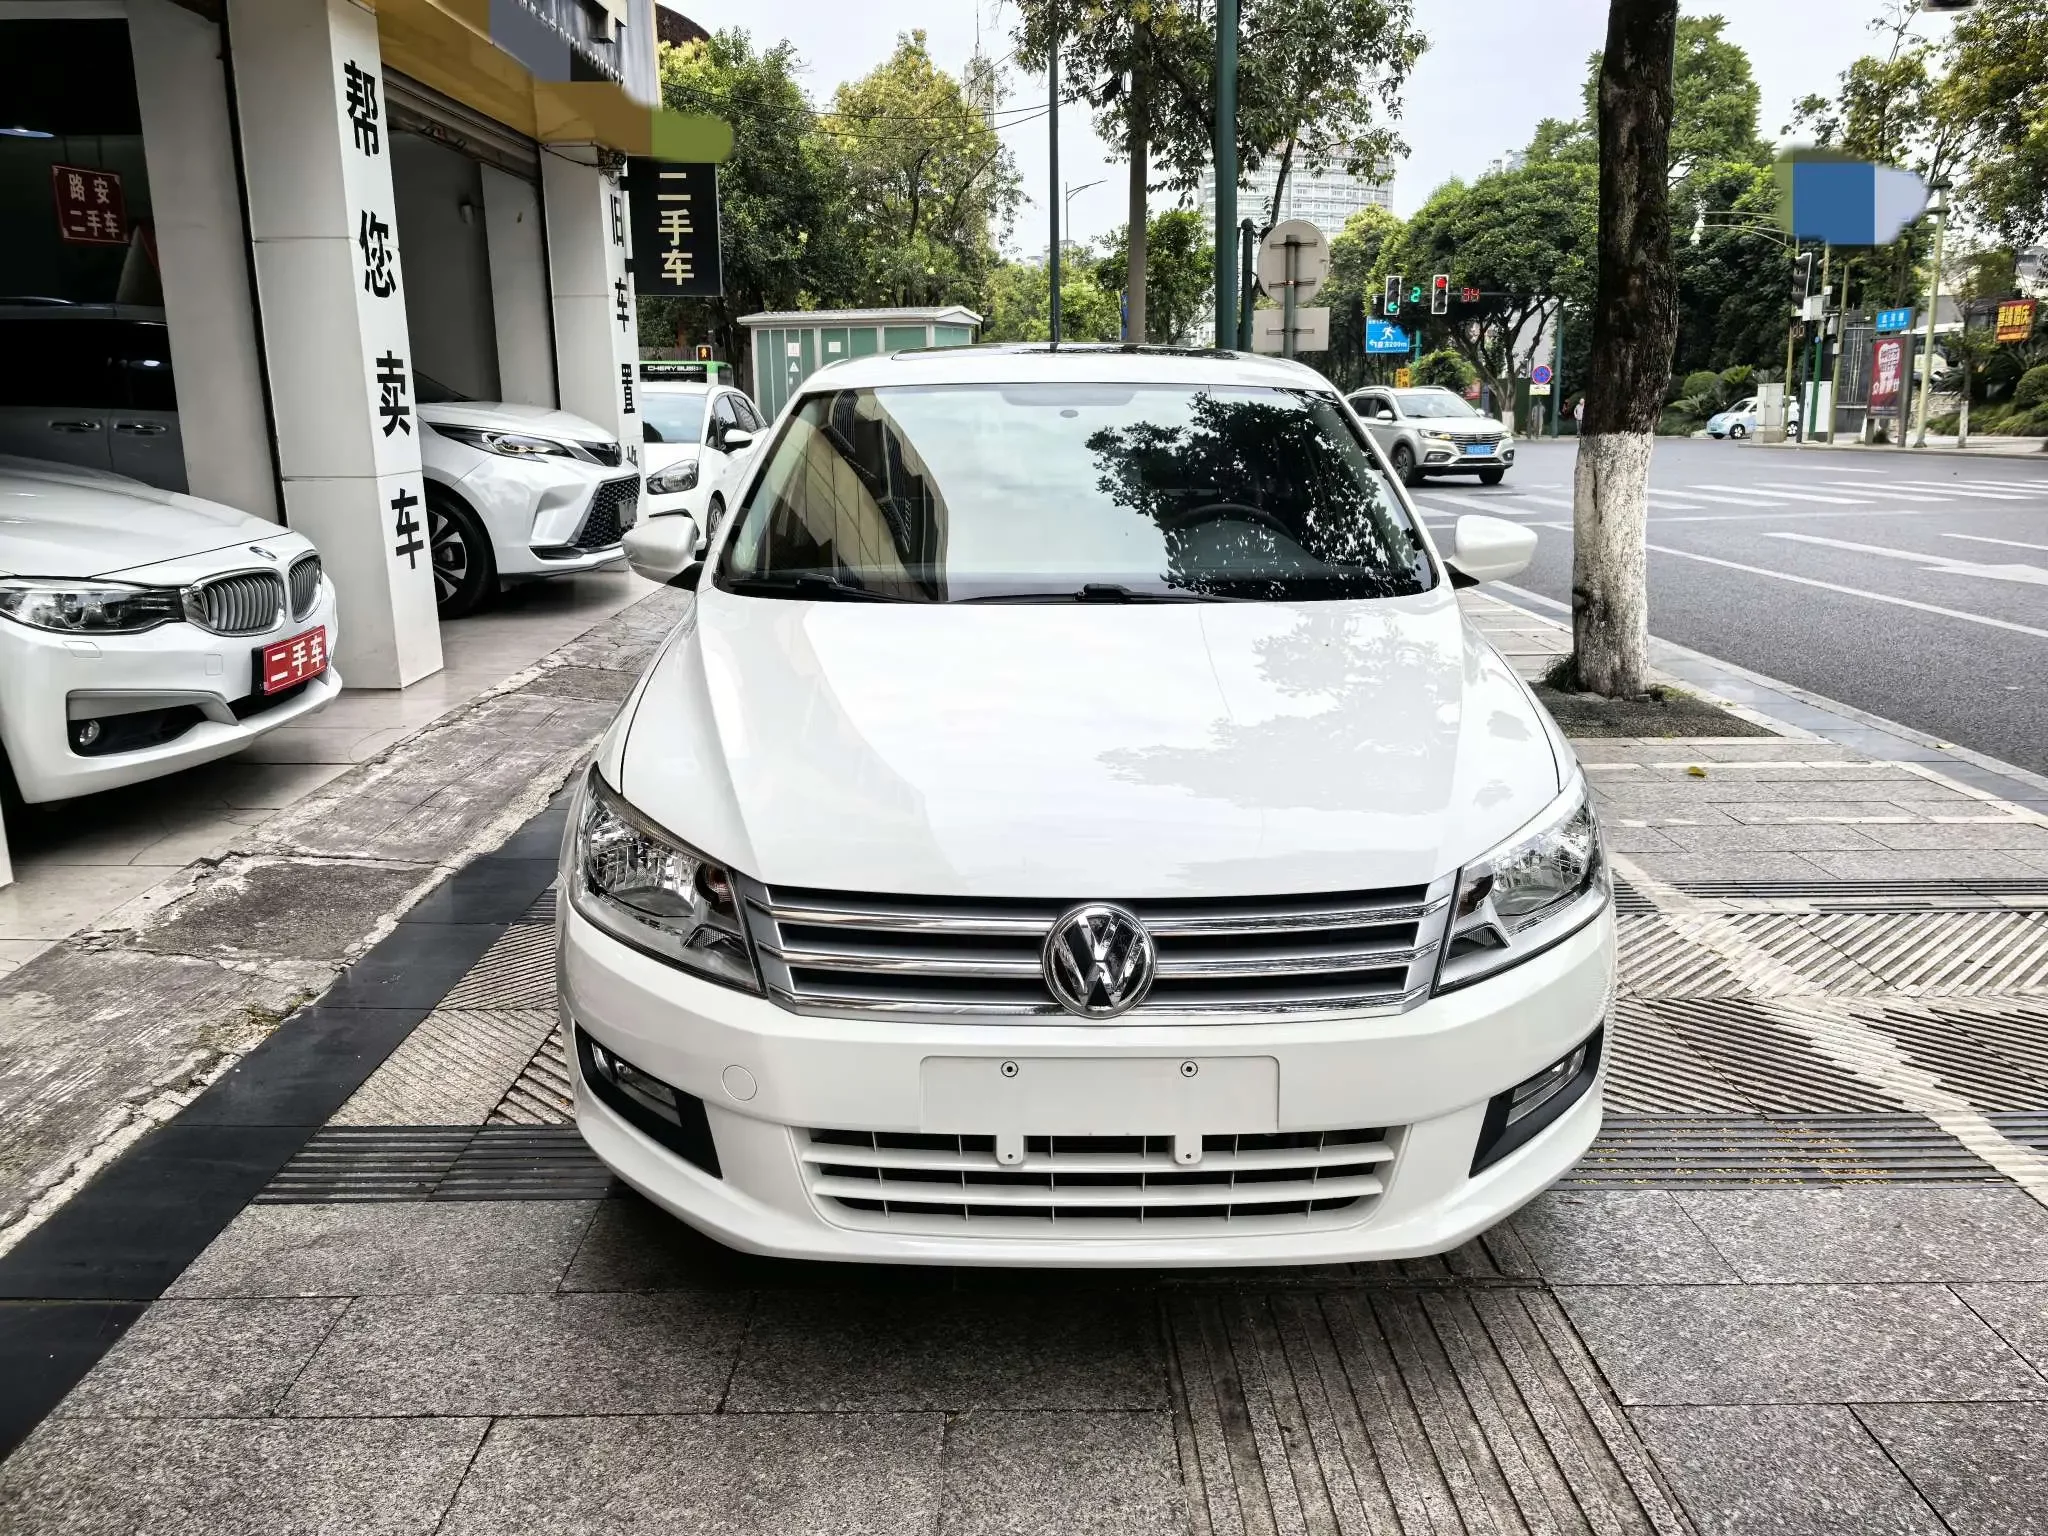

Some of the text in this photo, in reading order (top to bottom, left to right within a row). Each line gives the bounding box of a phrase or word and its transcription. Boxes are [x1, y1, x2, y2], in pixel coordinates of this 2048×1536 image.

[68, 173, 110, 204] 路安
[69, 210, 119, 238] 二手车
[657, 172, 695, 286] 二手车
[1410, 286, 1421, 303] 2
[1462, 287, 1480, 302] 34
[343, 59, 424, 570] 帮您卖车
[270, 635, 324, 682] 二手车
